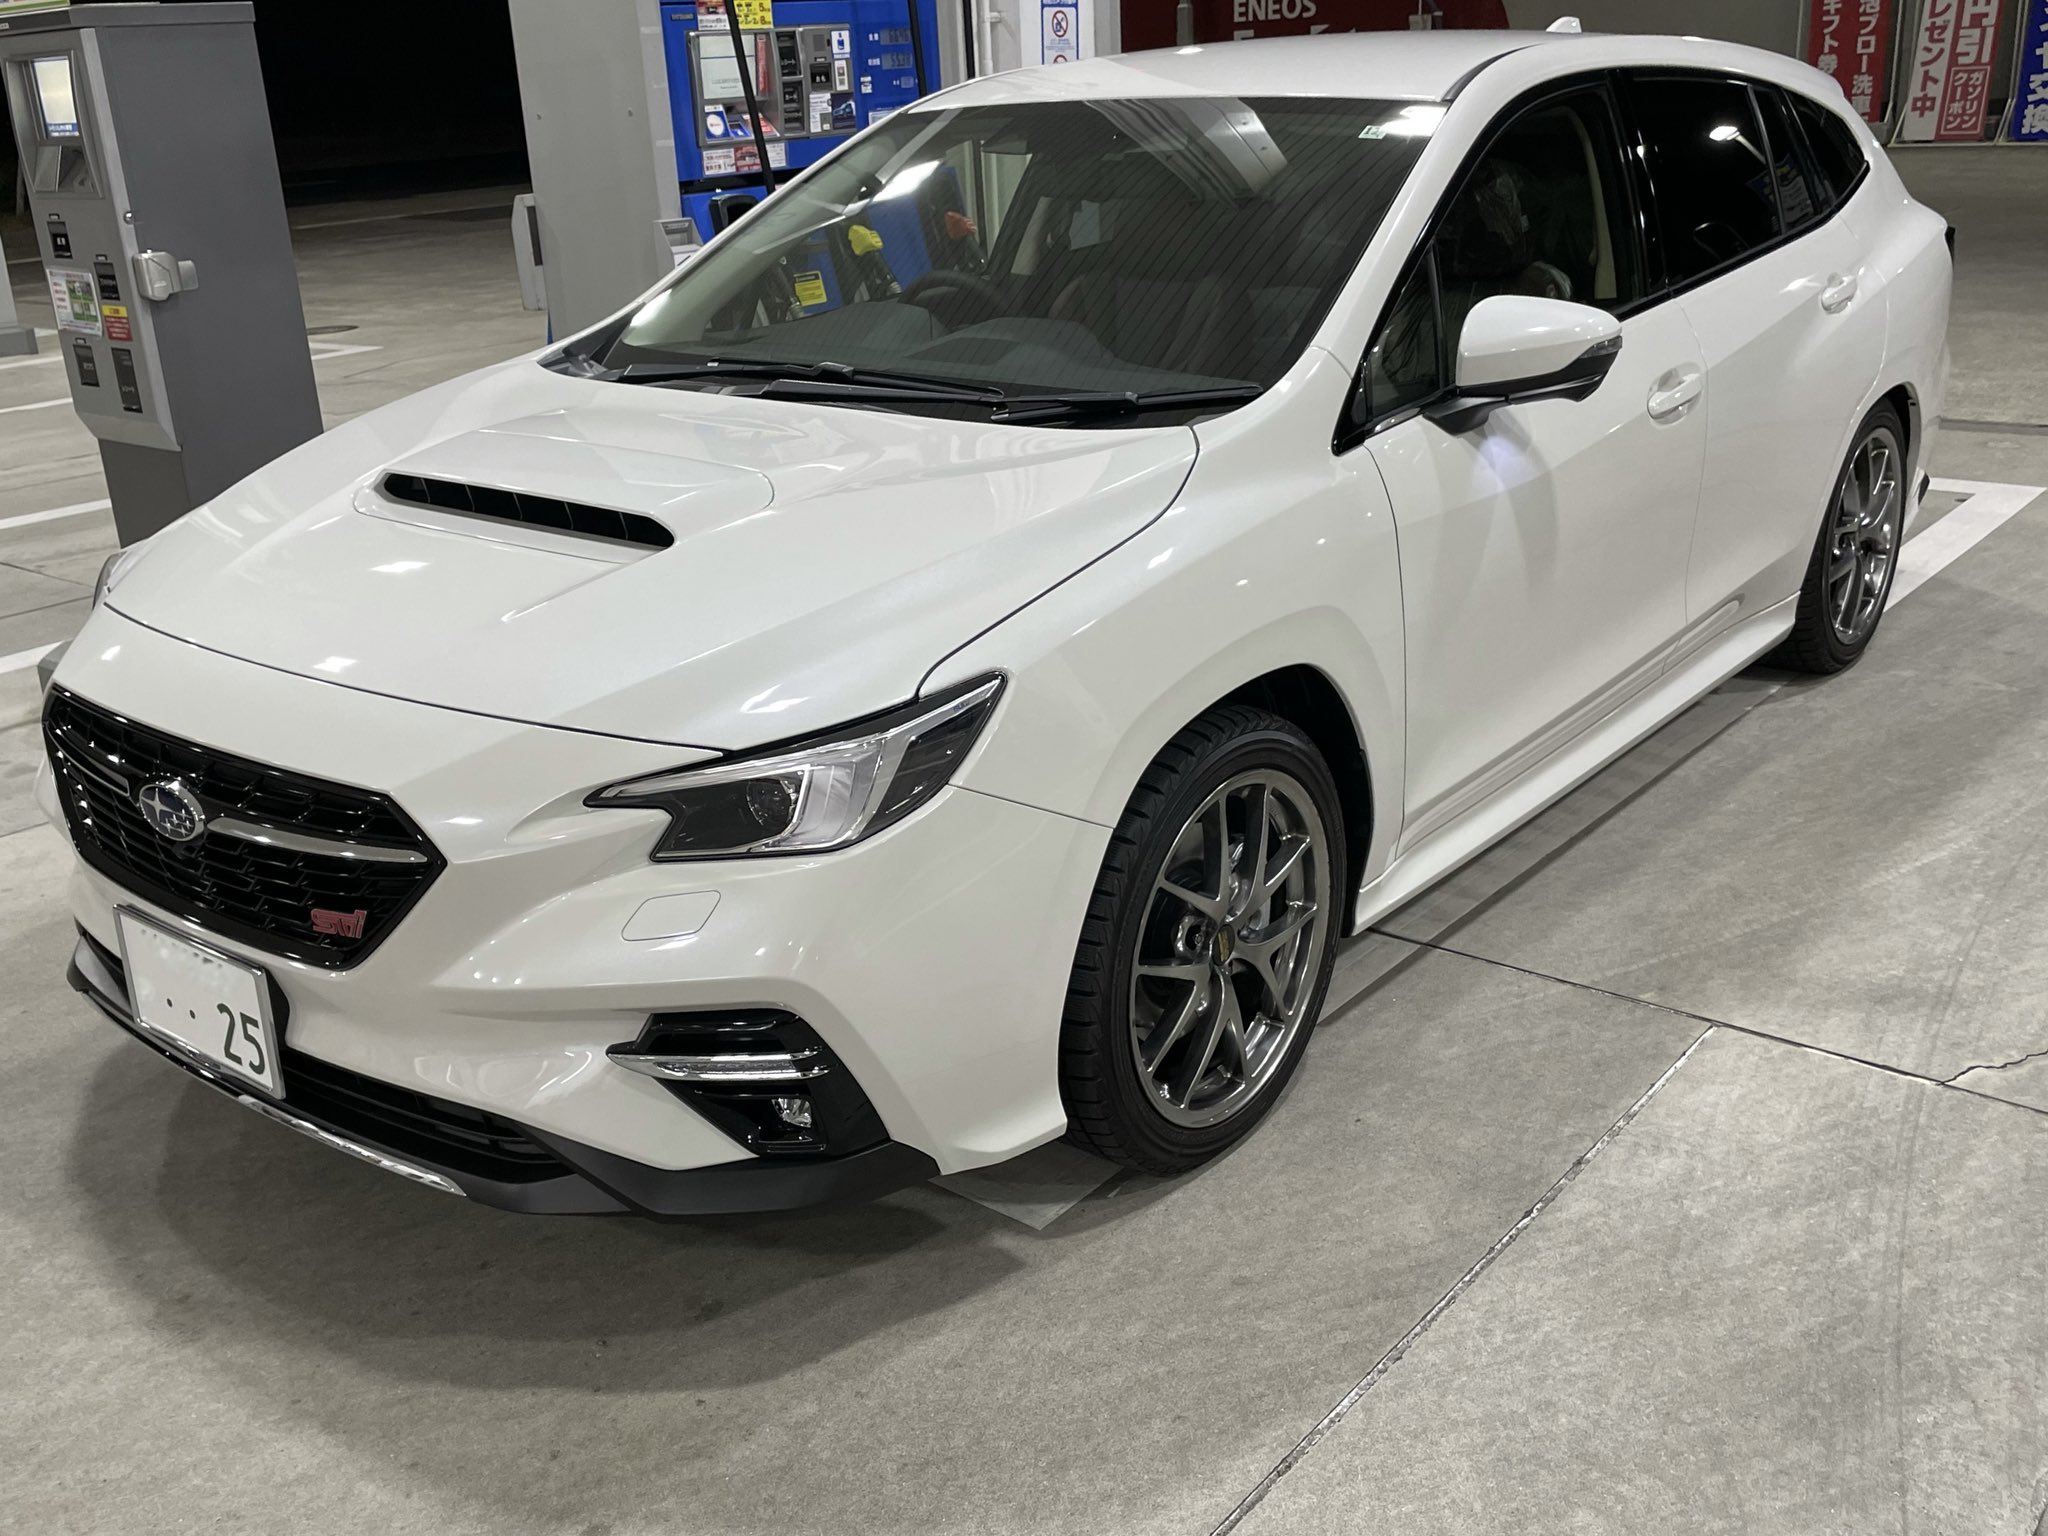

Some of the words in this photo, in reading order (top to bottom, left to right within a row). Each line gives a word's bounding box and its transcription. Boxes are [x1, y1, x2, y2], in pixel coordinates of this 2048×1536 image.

[1233, 0, 1317, 23] ENEOS
[1962, 70, 1986, 129] ガソリン
